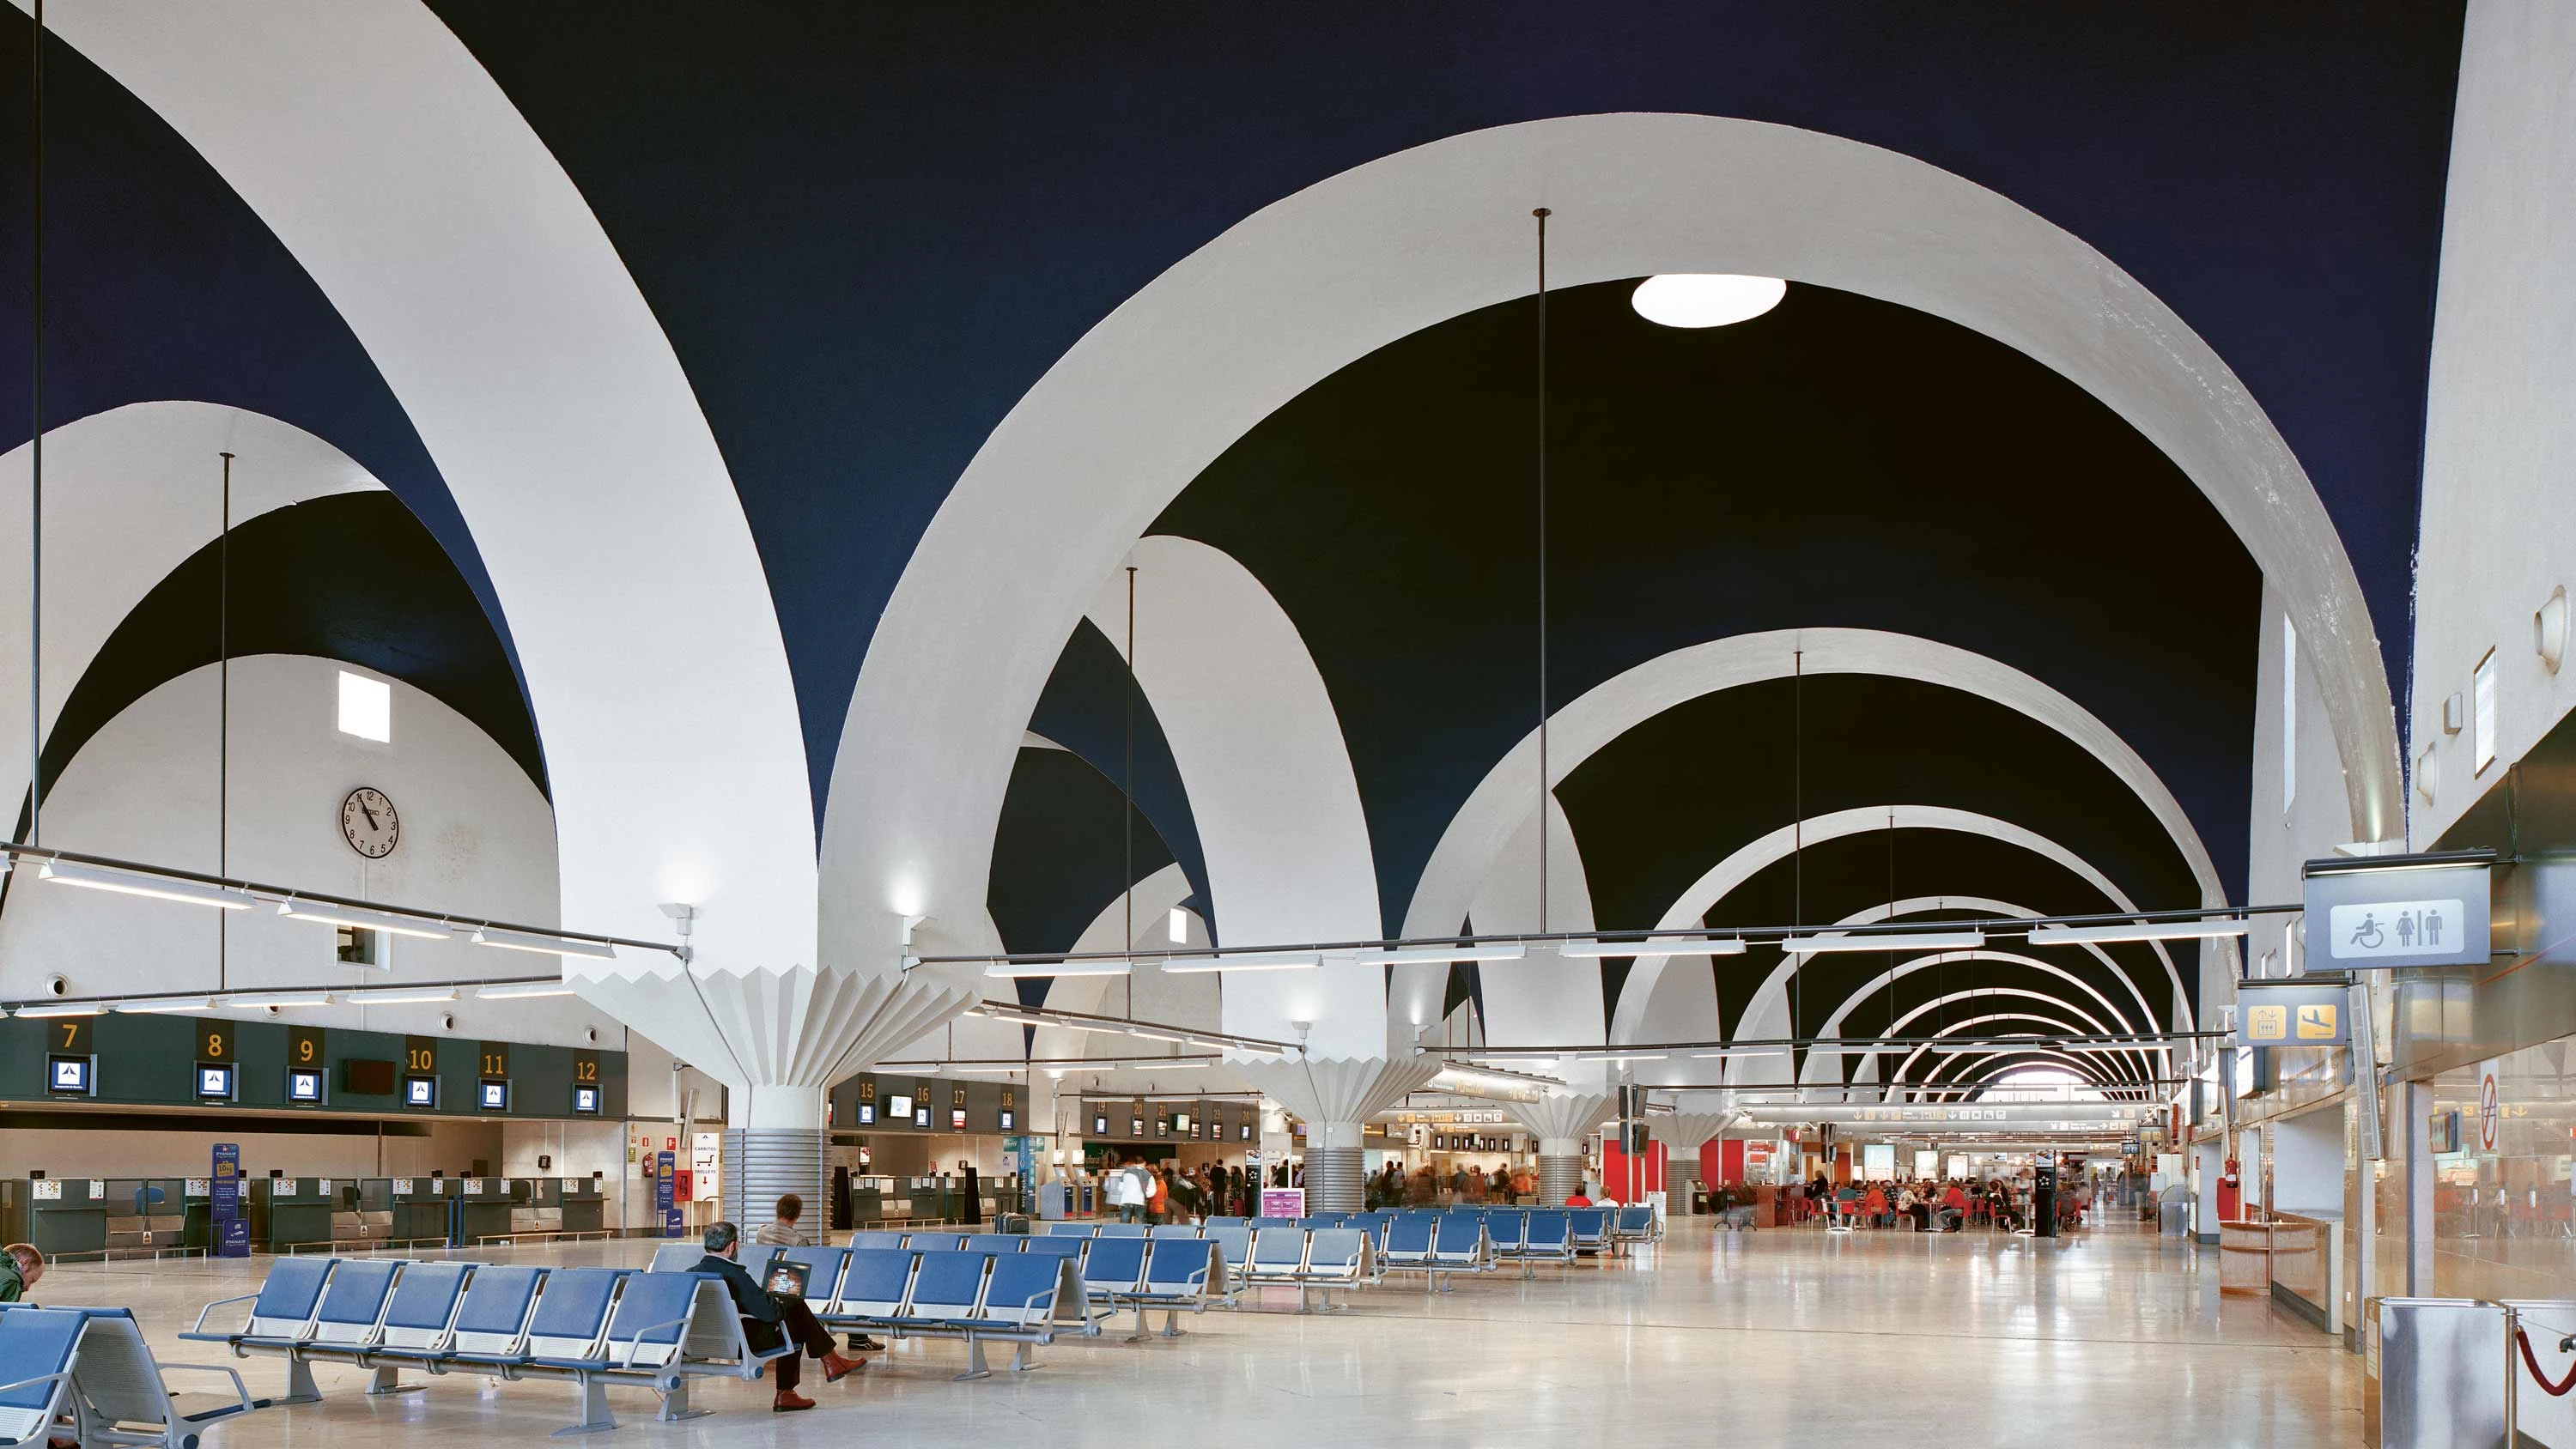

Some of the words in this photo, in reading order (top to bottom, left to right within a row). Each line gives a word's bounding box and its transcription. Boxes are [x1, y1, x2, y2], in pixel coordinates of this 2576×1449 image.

[367, 791, 374, 801] 12
[379, 797, 383, 806] 1
[348, 802, 355, 812] 10
[386, 807, 392, 816] 2
[345, 815, 350, 825] 9
[391, 822, 396, 831] 3
[349, 829, 355, 840] 8
[388, 835, 393, 845] 4
[360, 840, 365, 850] 7
[370, 845, 375, 855] 6
[380, 844, 386, 853] 5
[63, 1023, 78, 1048] 7
[208, 1034, 222, 1057] 8
[301, 1040, 314, 1062] 9
[410, 1049, 432, 1070] 10
[484, 1054, 504, 1075] 11
[578, 1061, 596, 1080] 12
[860, 1083, 873, 1099] 15
[917, 1087, 929, 1102] 16
[954, 1090, 965, 1104] 17
[1002, 1093, 1013, 1106] 18
[1097, 1101, 1106, 1113] 19
[1134, 1103, 1143, 1115] 20
[1158, 1105, 1166, 1117] 21
[1192, 1106, 1200, 1119] 22
